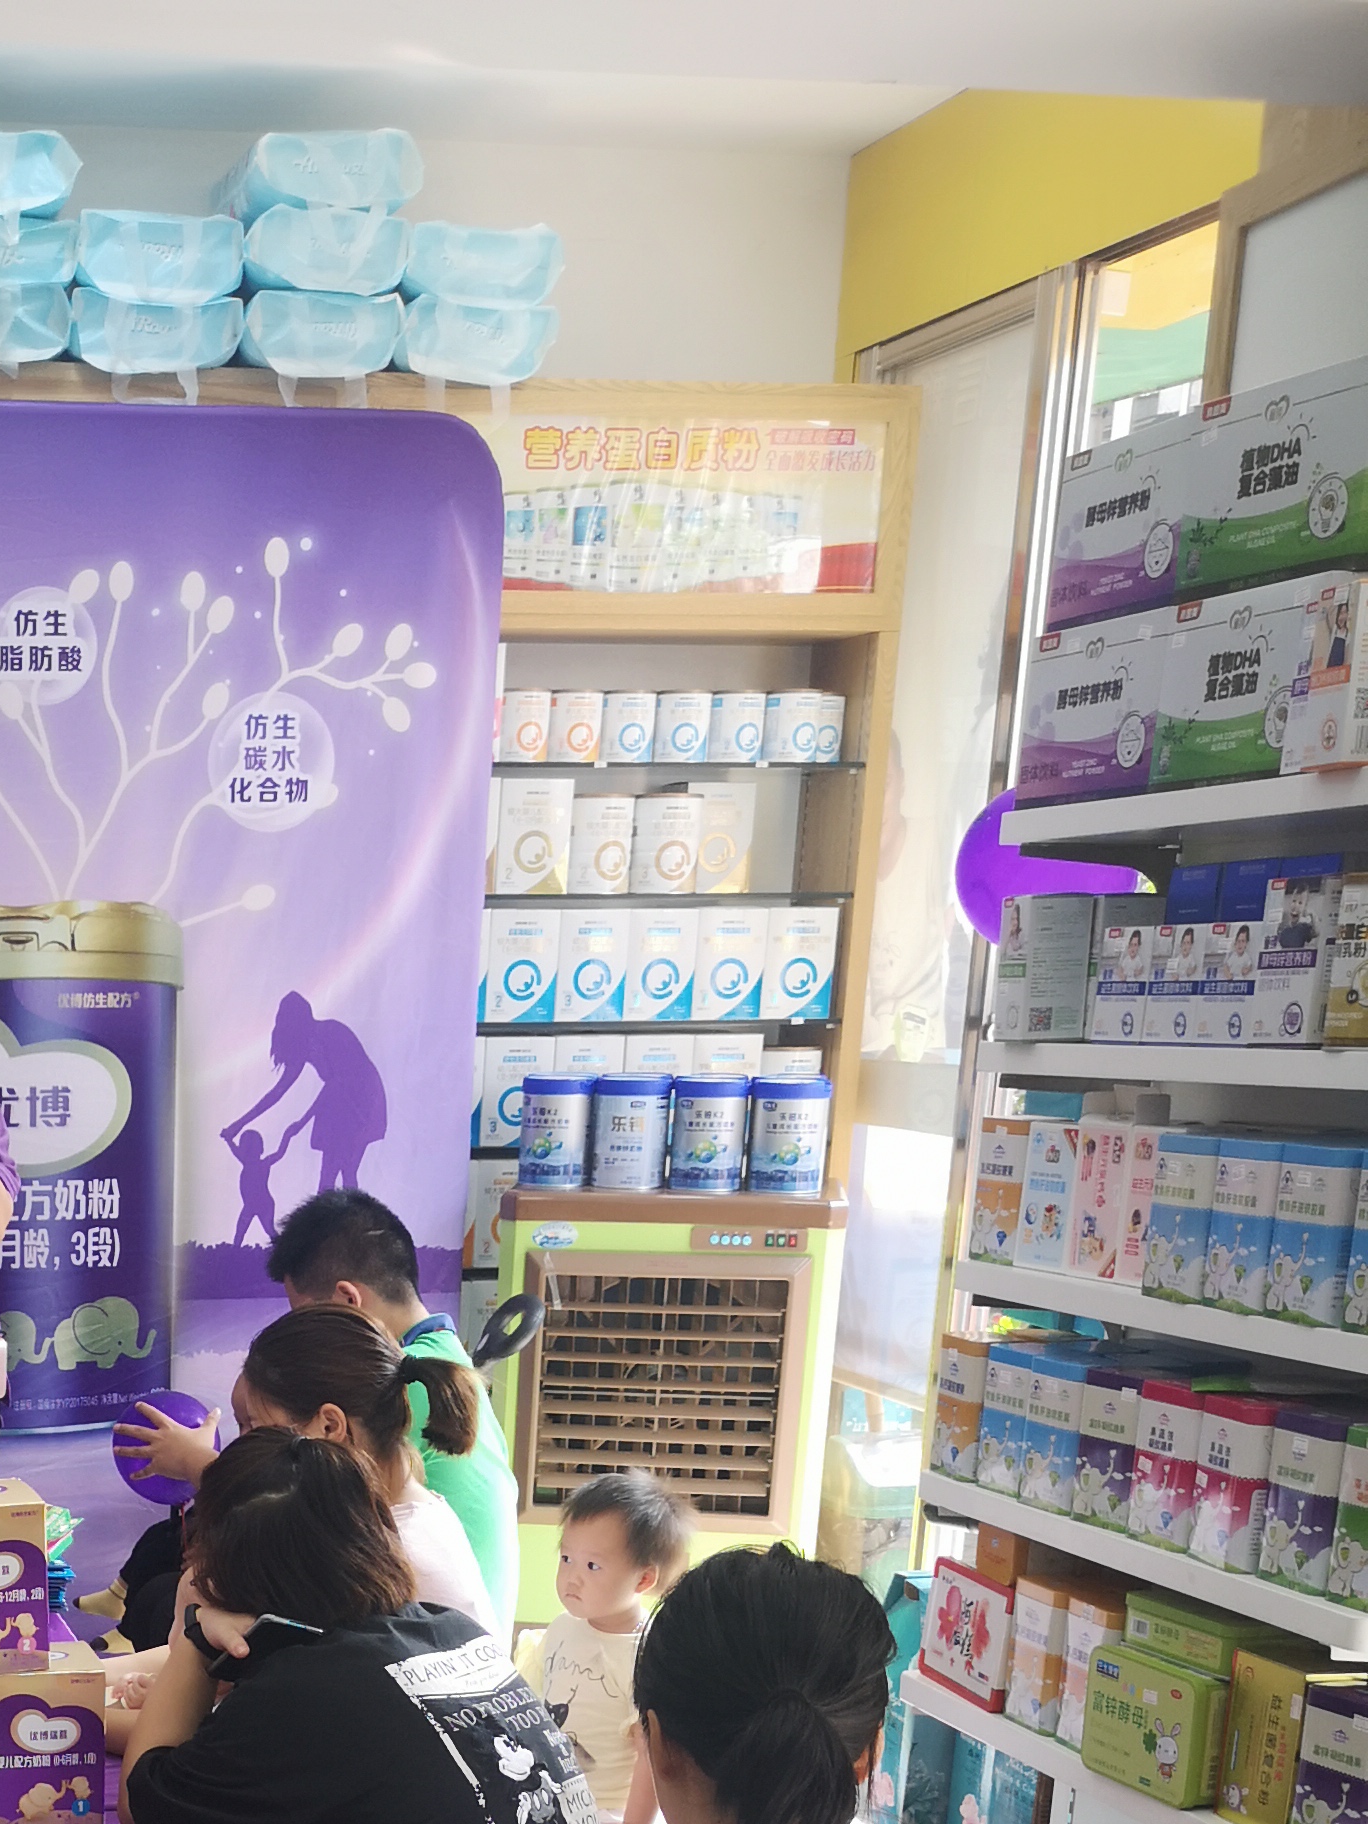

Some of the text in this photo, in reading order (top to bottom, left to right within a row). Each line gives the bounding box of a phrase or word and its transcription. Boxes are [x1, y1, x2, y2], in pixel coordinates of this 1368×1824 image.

[524, 426, 760, 472] 营养蛋白质粉
[1241, 438, 1302, 473] 植物DHA
[14, 610, 68, 638] 仿生
[1207, 648, 1261, 676] 植物DHA
[244, 713, 297, 740] 仿生
[243, 745, 297, 773] 碳水
[228, 777, 309, 805] 化合物
[57, 993, 132, 1009] 优博仿生配方
[22, 1639, 31, 1651] 2
[403, 1657, 457, 1686] PLAYIN'
[458, 1653, 475, 1669] IT
[443, 1708, 477, 1732] NO
[77, 1800, 84, 1812] 1
